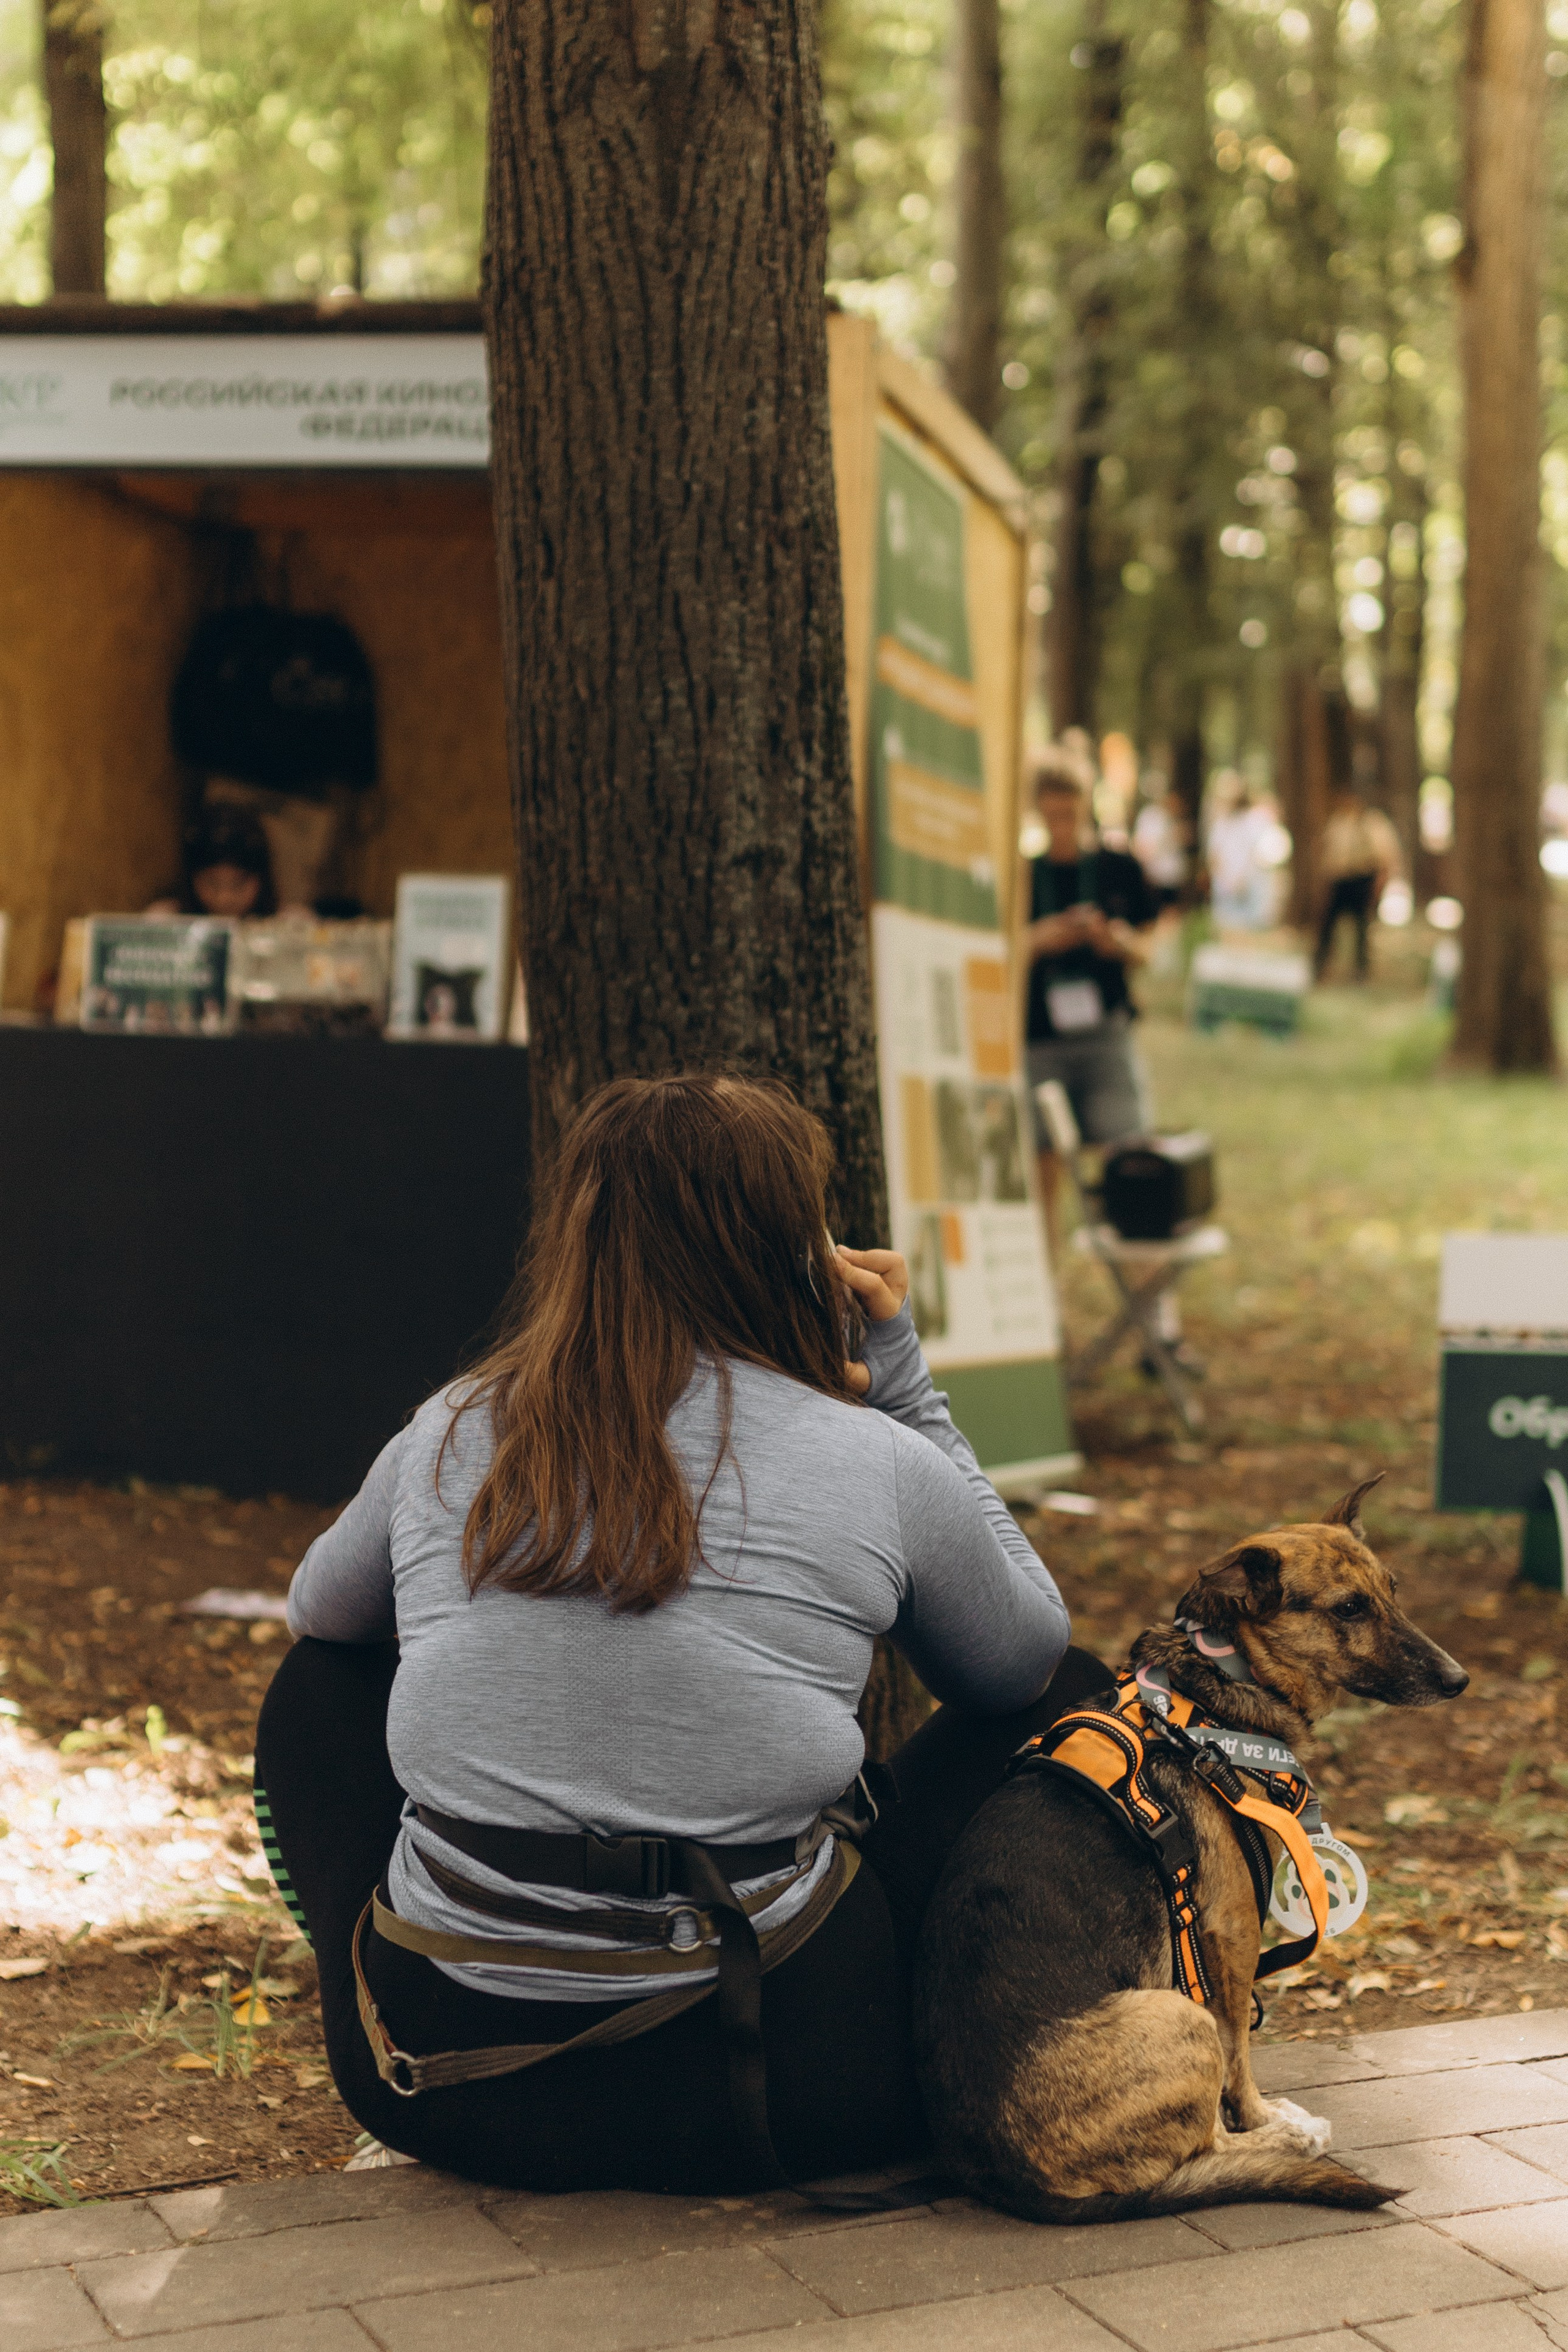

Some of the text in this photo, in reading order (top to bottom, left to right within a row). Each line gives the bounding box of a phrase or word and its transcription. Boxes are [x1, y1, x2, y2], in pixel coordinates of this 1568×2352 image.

[109, 372, 368, 408] РОССИЙСКАЯ
[1242, 1743, 1264, 1759] ЗА
[1268, 1747, 1300, 1768] ЕГИ
[1311, 1838, 1351, 1857] ДРУГОМ
